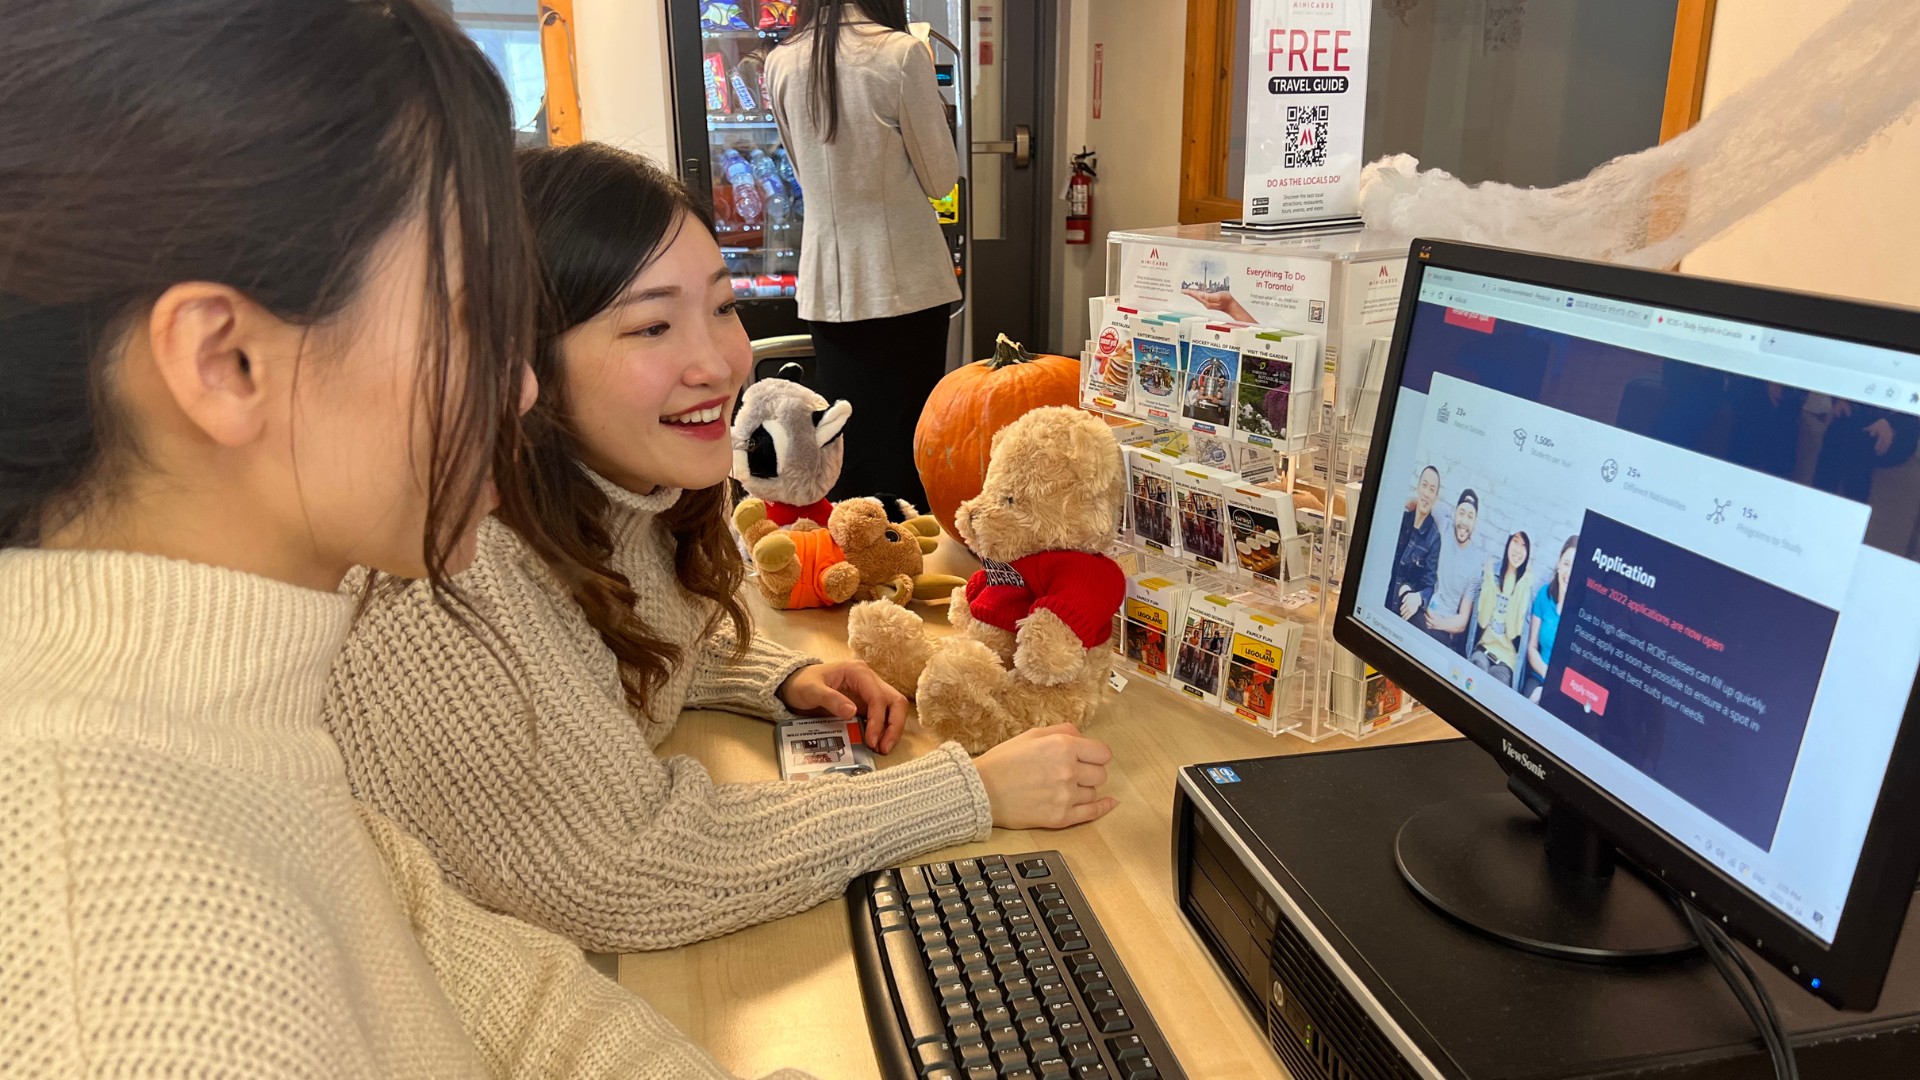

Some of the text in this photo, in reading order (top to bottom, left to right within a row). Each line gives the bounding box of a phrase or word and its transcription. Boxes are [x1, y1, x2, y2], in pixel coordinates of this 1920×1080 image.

[1268, 29, 1351, 72] FREE
[1273, 78, 1345, 92] TRAVEL GUIDE
[1267, 175, 1341, 187] DO AS THE LOCALS DO!
[1246, 267, 1306, 281] Everything To Do
[1264, 280, 1294, 292] Toronto!
[1137, 332, 1171, 341] ENTERTAINMENT
[1192, 339, 1210, 347] HOCKEY
[1229, 344, 1240, 352] FAME
[1269, 352, 1289, 361] GARDEN
[1455, 407, 1467, 417] 23+
[1534, 434, 1555, 448] 1,500+
[1626, 467, 1641, 479] 25+
[1742, 507, 1758, 521] 15+
[1737, 522, 1771, 543] Programs
[1592, 547, 1656, 589] Application
[1137, 610, 1163, 625] LEGOLAND
[1586, 577, 1725, 653] Winter 2022 applications are now open
[1246, 630, 1273, 643] FAMILY FUN
[1245, 647, 1275, 664] LEGOLAND
[1578, 608, 1592, 622] Due
[1592, 616, 1600, 626] to
[1600, 619, 1616, 635] high
[1616, 627, 1645, 652] demand,
[1667, 655, 1695, 676] classes
[1695, 670, 1711, 684] can
[1711, 675, 1722, 690] fill
[1722, 684, 1735, 698] up
[1570, 641, 1705, 725] the schedule that best suits your needs.
[1574, 624, 1760, 732] Please apply as soon as possible to ensure a spot in
[1500, 737, 1547, 781] ViewSonic
